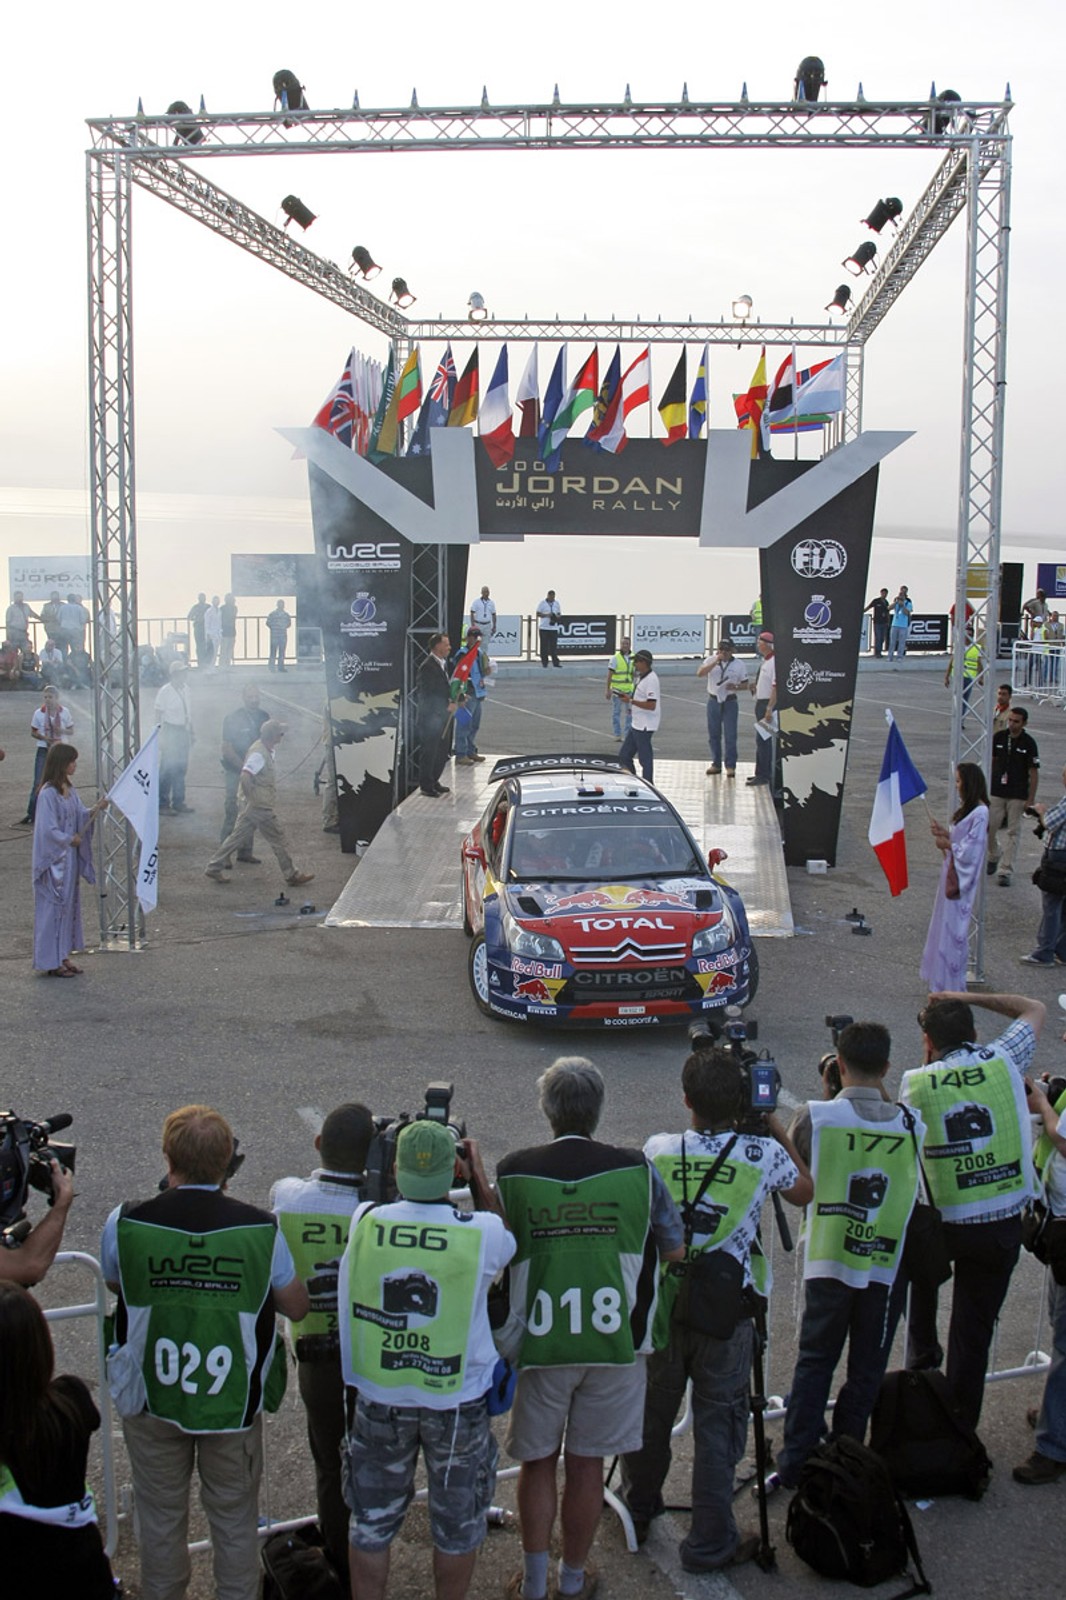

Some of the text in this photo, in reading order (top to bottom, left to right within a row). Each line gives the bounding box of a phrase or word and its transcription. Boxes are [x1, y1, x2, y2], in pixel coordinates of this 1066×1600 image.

[496, 472, 682, 495] JORDAN
[592, 500, 682, 511] RALLY
[326, 543, 401, 559] WRC
[636, 629, 702, 638] JORDAN
[494, 757, 623, 774] CITROËN C4
[521, 804, 667, 818] CITROËN C4
[573, 917, 675, 932] TOTAL
[511, 957, 563, 980] Red Bull
[697, 955, 723, 973] Red
[574, 967, 685, 985] CITROËN
[527, 1005, 557, 1015] PIRELLI
[603, 1016, 652, 1026] le coq sportif
[927, 1066, 986, 1090] 148
[846, 1132, 905, 1155] 177
[926, 1146, 970, 1156] PHOTOGRAPHER
[953, 1152, 997, 1173] 2008
[528, 1202, 620, 1225] WRC
[375, 1223, 449, 1251] 166
[846, 1220, 878, 1240] 200
[148, 1255, 245, 1278] WRC
[169, 1279, 203, 1288] WORLD
[204, 1282, 239, 1291] RALLY
[355, 1307, 405, 1328] PHOTOGRAPHER
[527, 1286, 622, 1337] 018
[382, 1330, 431, 1352] 2008
[154, 1336, 234, 1396] 029
[392, 1360, 404, 1369] 24
[411, 1358, 422, 1367] 27
[422, 1362, 440, 1375] April
[441, 1365, 452, 1375] 08
